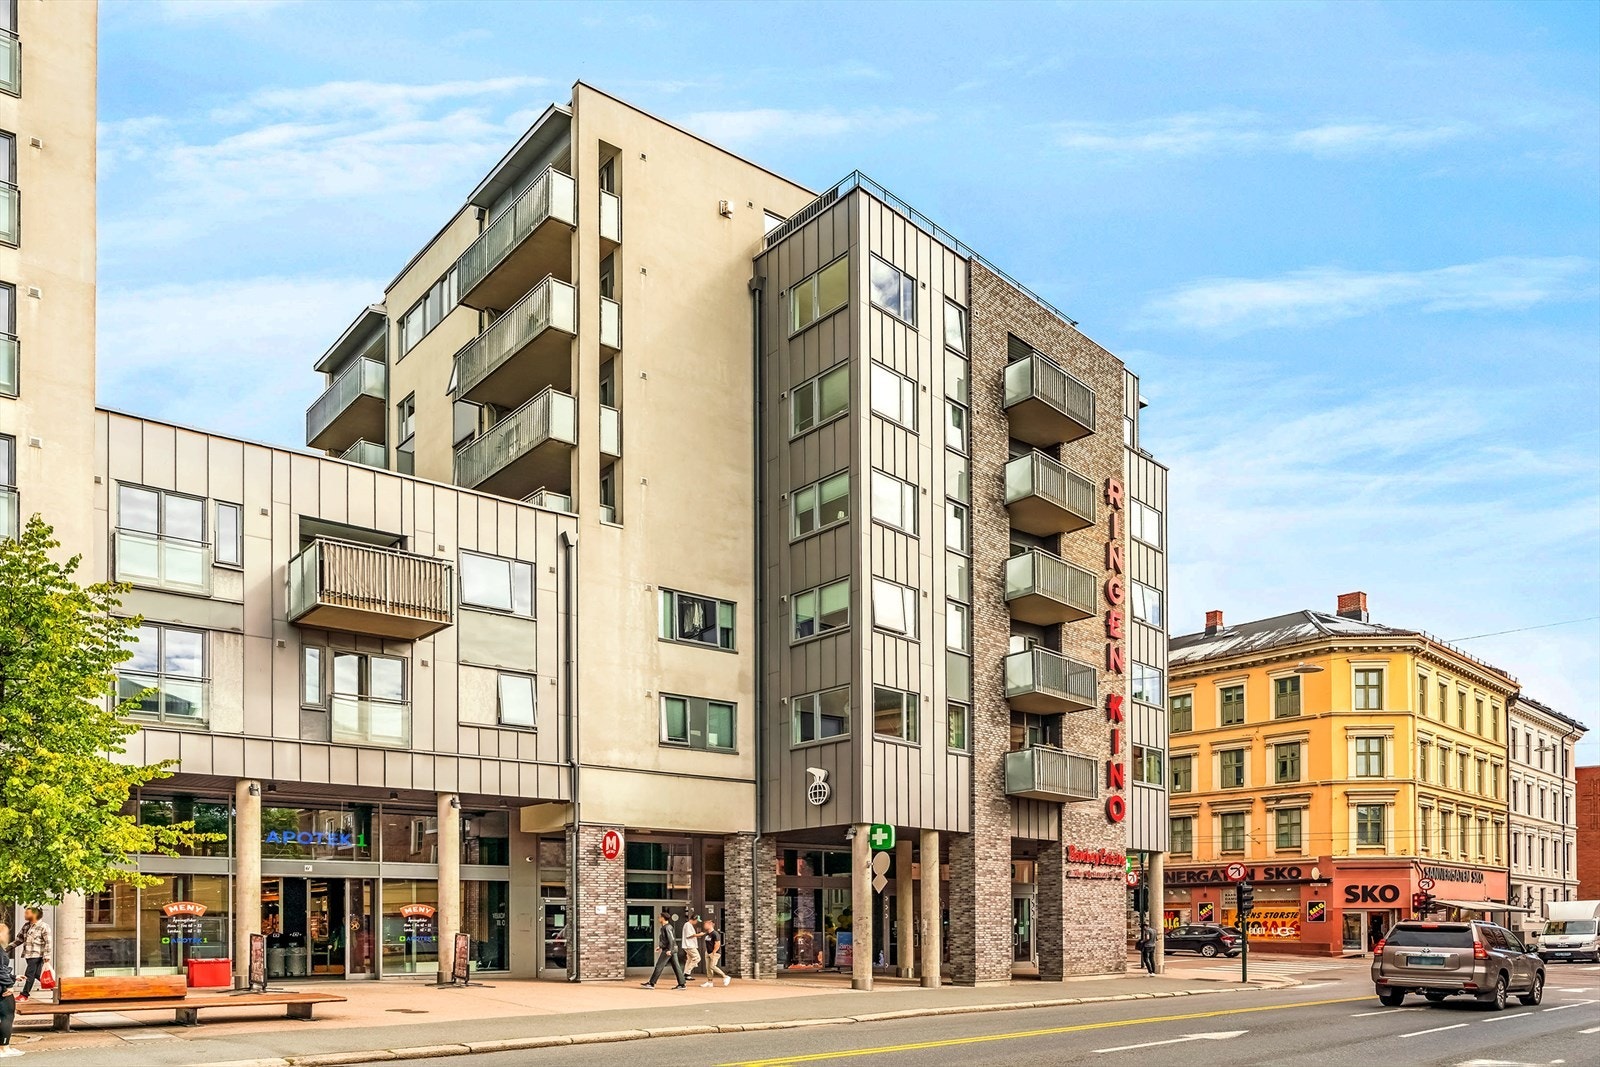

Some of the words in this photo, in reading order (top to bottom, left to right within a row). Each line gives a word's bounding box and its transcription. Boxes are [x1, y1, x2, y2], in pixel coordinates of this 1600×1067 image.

[1104, 477, 1125, 676] RINGEN
[1105, 693, 1126, 825] KINO
[265, 830, 352, 847] APOTEK
[357, 833, 367, 847] 1
[1263, 866, 1302, 880] SKO
[1344, 884, 1400, 903] SKO
[168, 904, 203, 913] MENY
[404, 906, 432, 914] MENY
